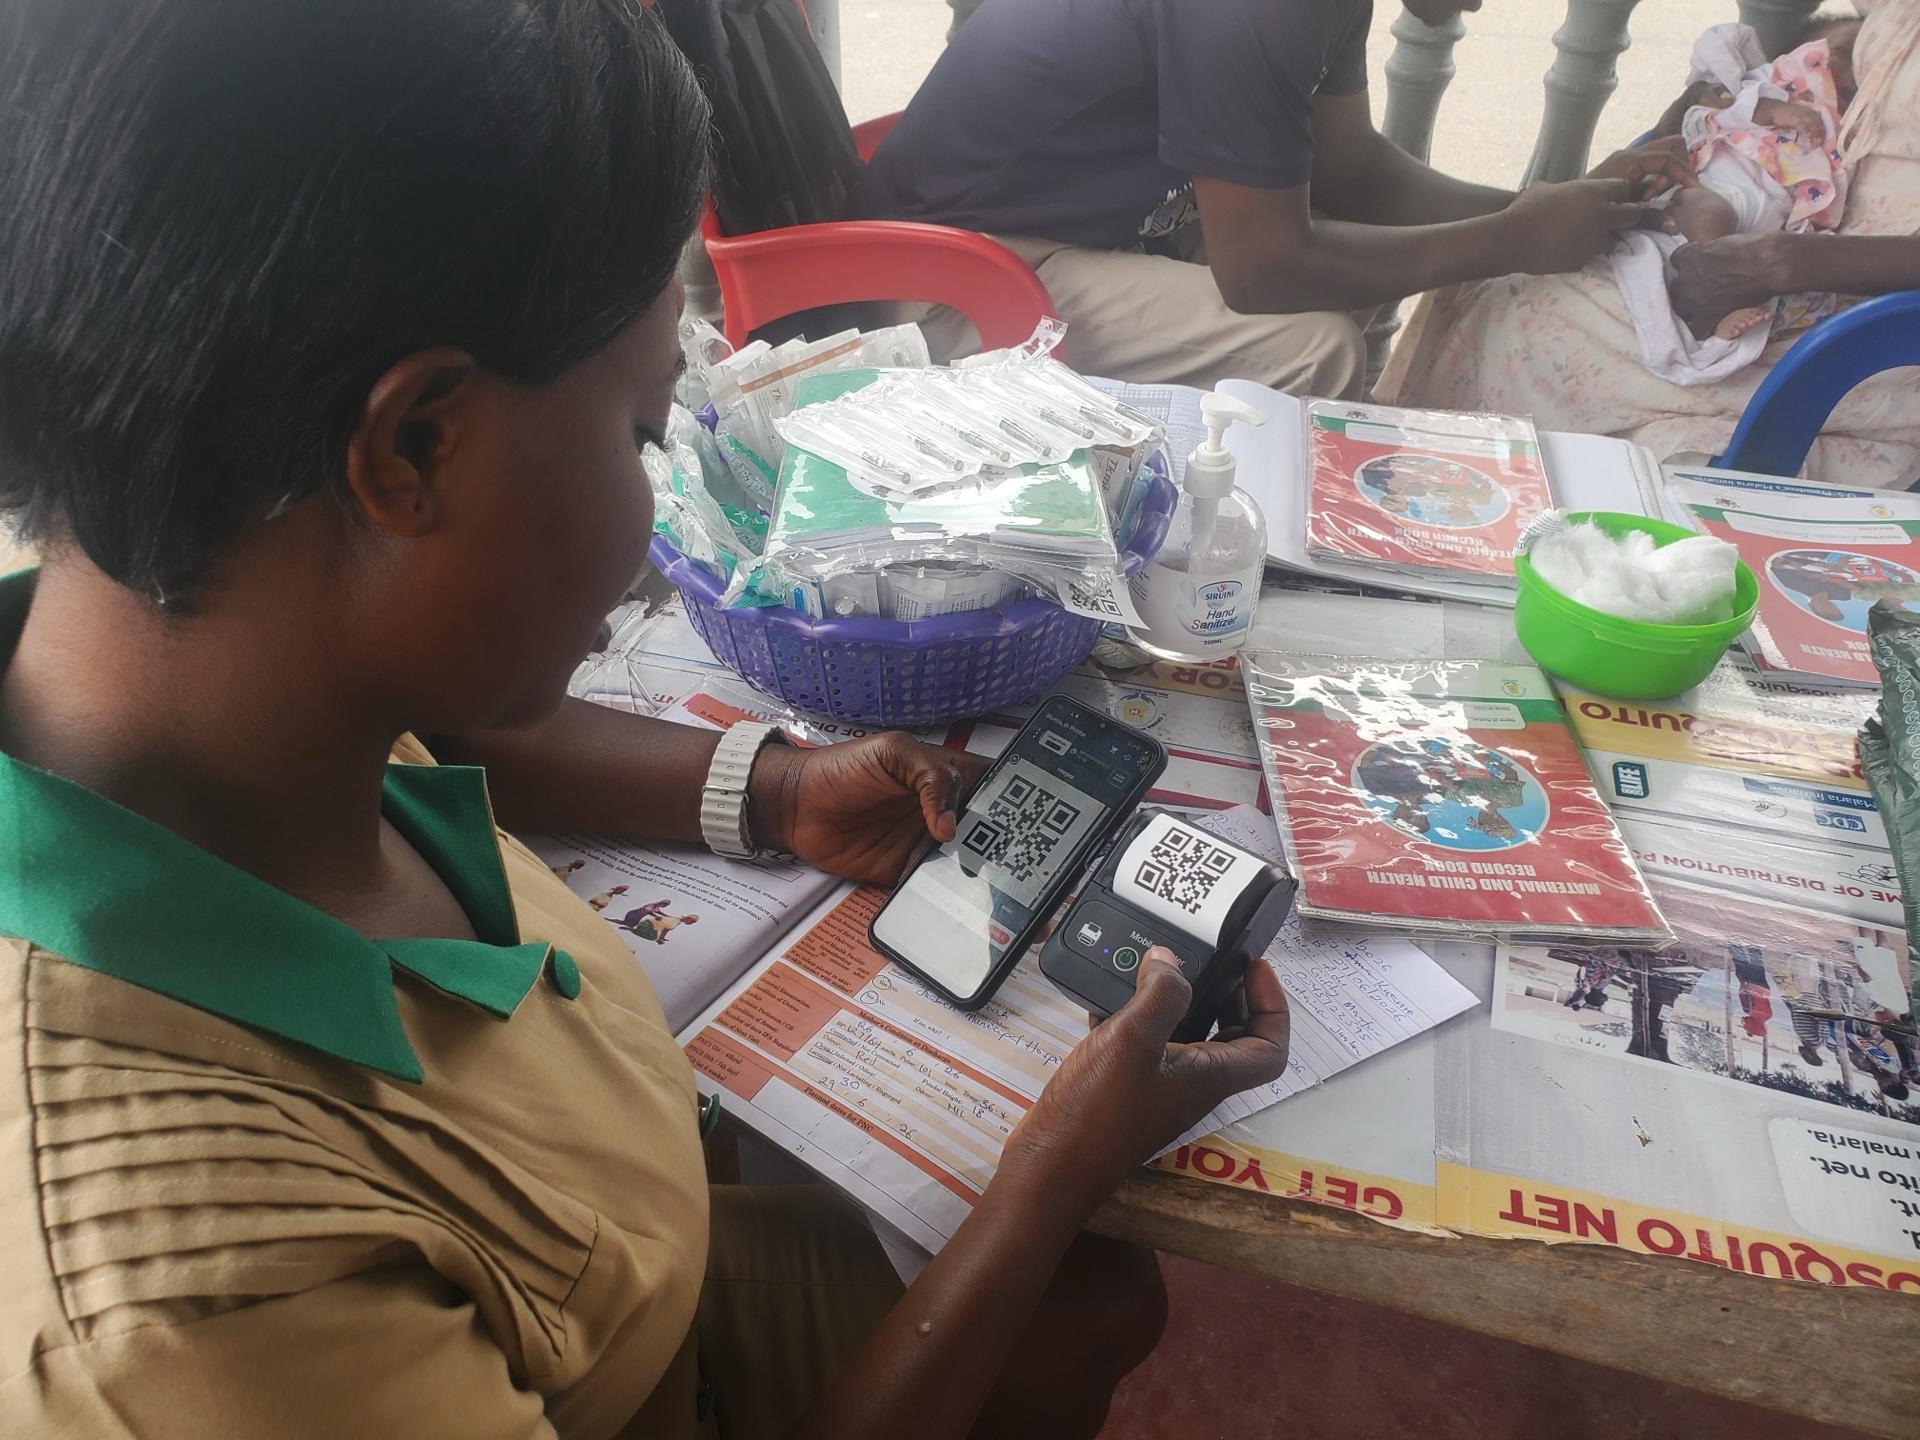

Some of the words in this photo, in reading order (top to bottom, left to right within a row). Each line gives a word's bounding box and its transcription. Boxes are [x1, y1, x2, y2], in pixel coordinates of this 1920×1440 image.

[1206, 606, 1235, 619] Hand
[1191, 615, 1237, 629] Sanitizer
[839, 723, 868, 739] OF
[1068, 725, 1087, 737] Printer
[1618, 766, 1642, 788] LIFE
[1836, 794, 1876, 808] Malaria
[1817, 813, 1864, 831] CDC
[1424, 861, 1469, 873] BOOK
[1472, 863, 1536, 876] RECORD
[1663, 854, 1825, 891] DISTRIBUTION
[1366, 871, 1426, 887] HEALTH
[1429, 874, 1477, 890] CHILD
[1480, 878, 1513, 891] AND
[1516, 880, 1601, 895] MATERNAL
[1834, 886, 1864, 897] OF
[1872, 890, 1904, 903] ME
[1128, 930, 1157, 949] Mobile
[858, 1010, 885, 1028] Mother's
[884, 1025, 913, 1044] Condition
[920, 1044, 952, 1065] Discharge
[828, 1026, 858, 1045] Contracted
[870, 1049, 901, 1069] Contracted
[839, 1075, 861, 1091] 30
[845, 1068, 872, 1086] Lactating
[874, 1086, 902, 1104] Engorged
[802, 1087, 831, 1105] Planned
[829, 1102, 848, 1116] dates
[855, 1119, 874, 1132] PNC
[897, 1124, 917, 1139] 26
[795, 1144, 805, 1152] 21
[1807, 1129, 1910, 1159] malaria.
[1175, 1146, 1269, 1191] YOU
[1810, 1156, 1870, 1180] net.
[1287, 1170, 1402, 1220] GET
[1499, 1189, 1618, 1244] NET
[1637, 1219, 1920, 1291] OSQUITO
